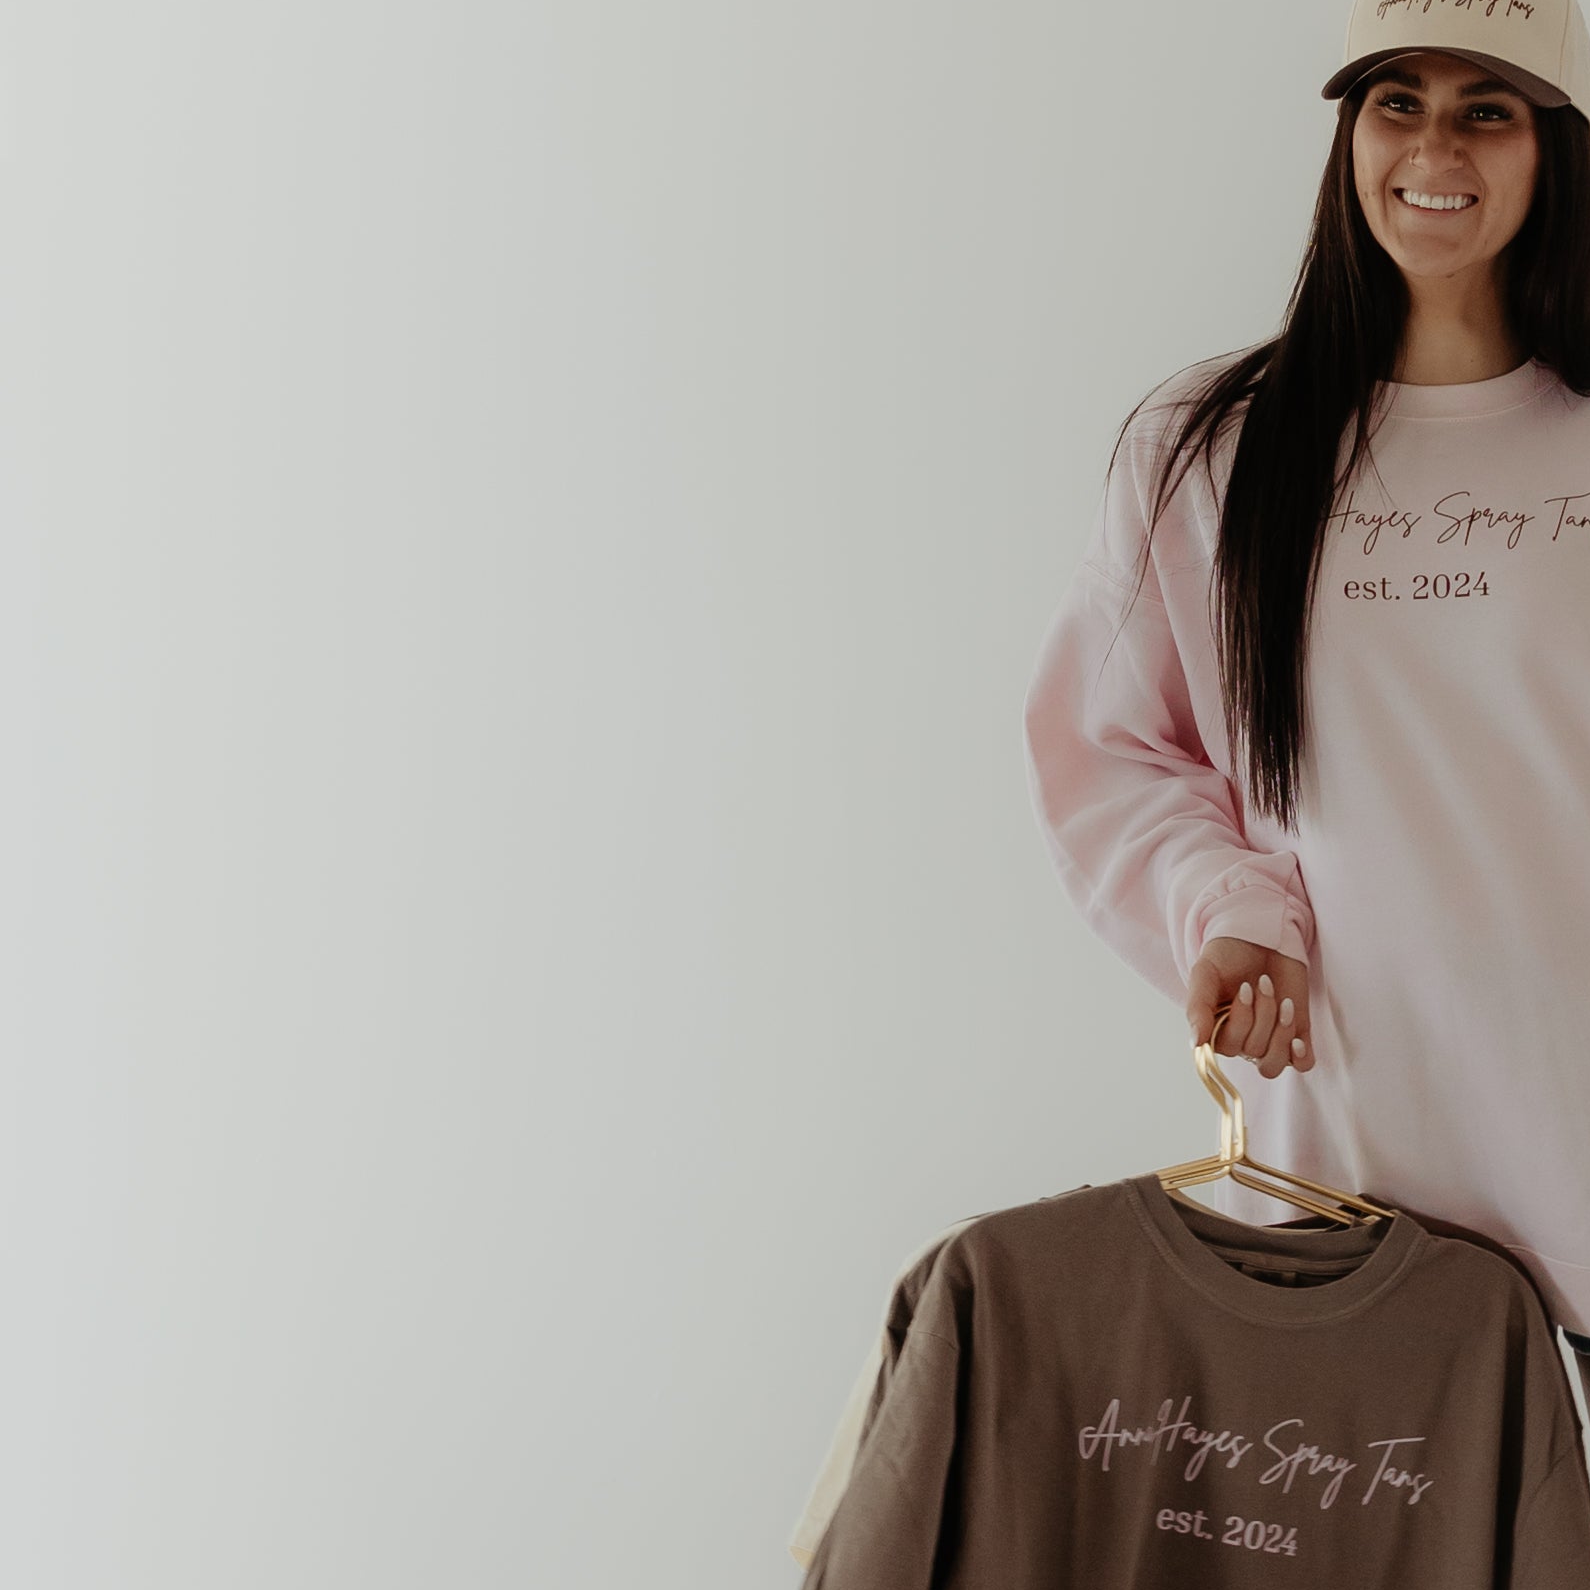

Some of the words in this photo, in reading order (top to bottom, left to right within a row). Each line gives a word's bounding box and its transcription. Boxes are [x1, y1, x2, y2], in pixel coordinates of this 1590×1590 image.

[1322, 490, 1422, 555] Hayes
[1433, 491, 1535, 549] Spray
[1343, 576, 1401, 601] est.
[1412, 571, 1490, 600] 2024
[1259, 1418, 1356, 1510] Spray
[1361, 1436, 1433, 1505] Tans
[1156, 1508, 1213, 1540] est.
[1221, 1515, 1298, 1556] 2024
